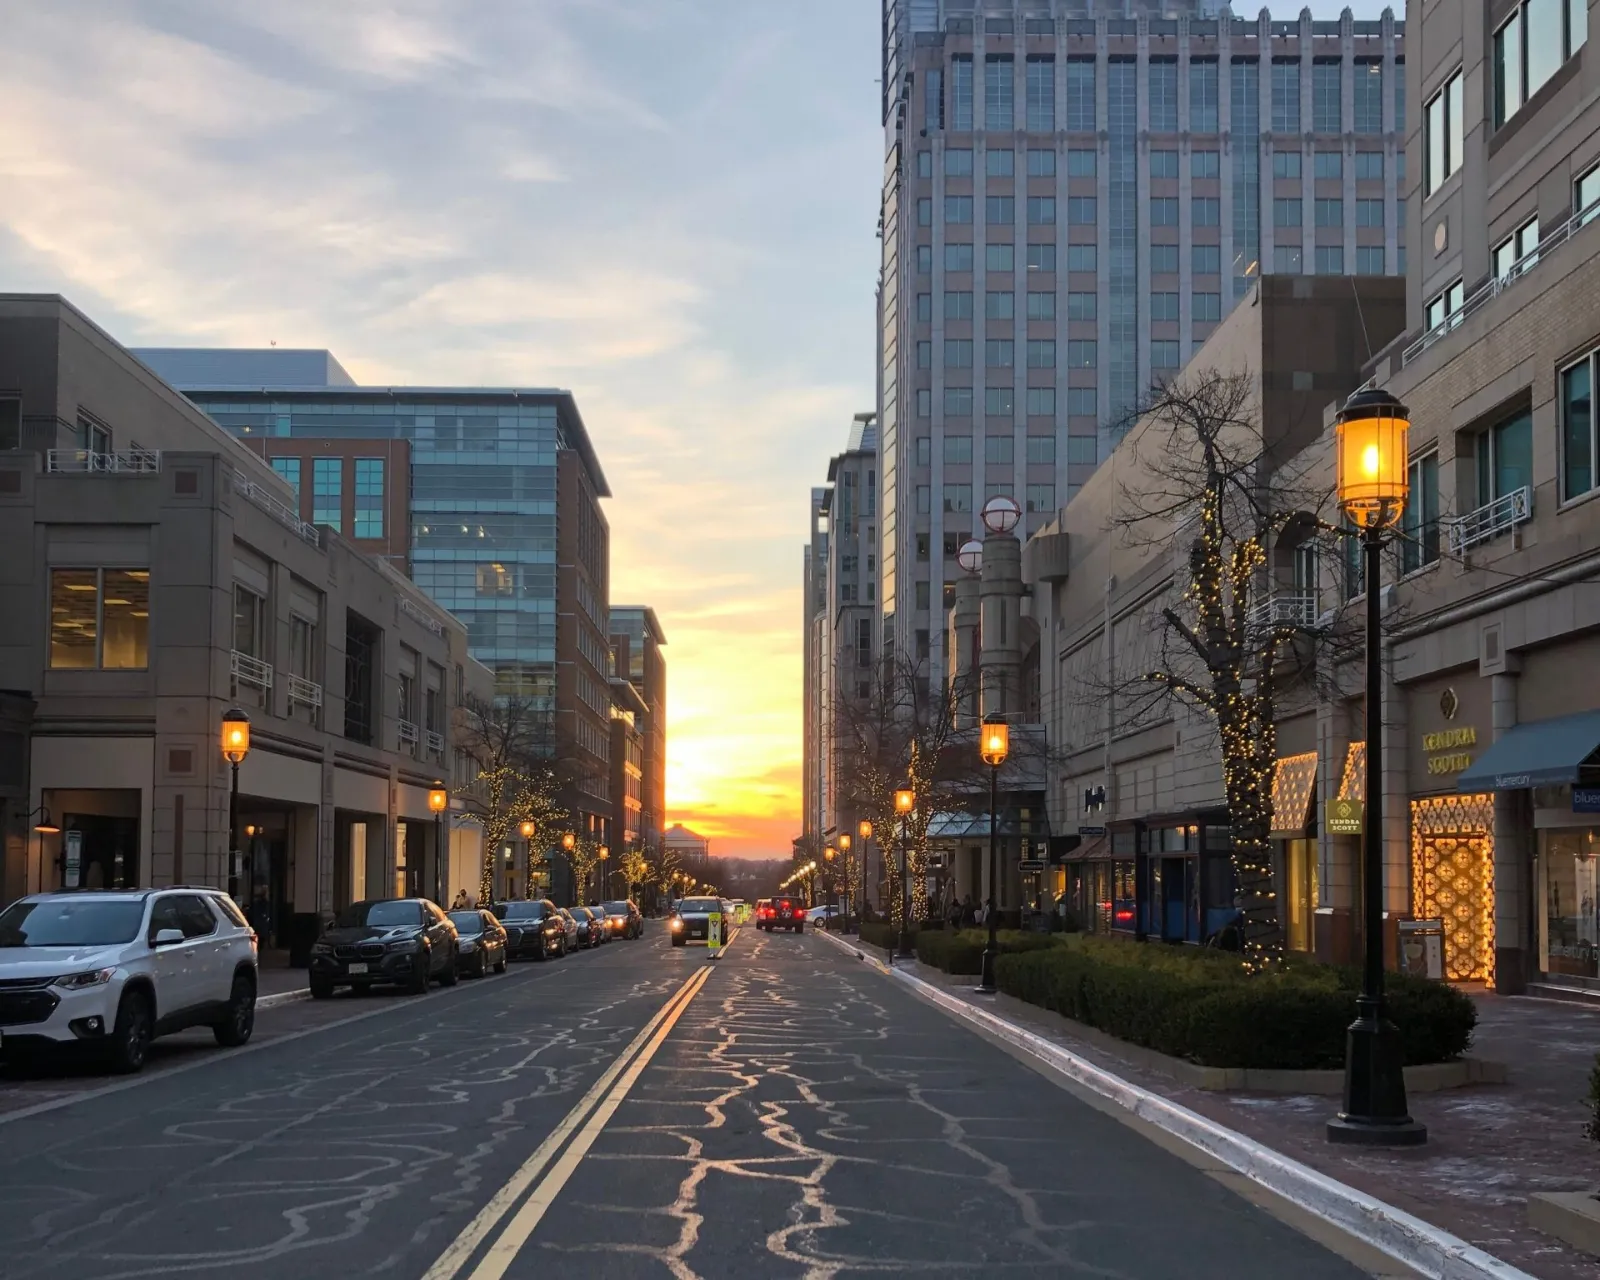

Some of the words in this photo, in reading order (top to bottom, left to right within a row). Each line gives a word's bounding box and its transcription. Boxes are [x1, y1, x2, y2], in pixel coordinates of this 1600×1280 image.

[1422, 727, 1476, 751] KENDRA
[1427, 753, 1470, 774] SCOTT
[1495, 774, 1531, 788] bluemercury
